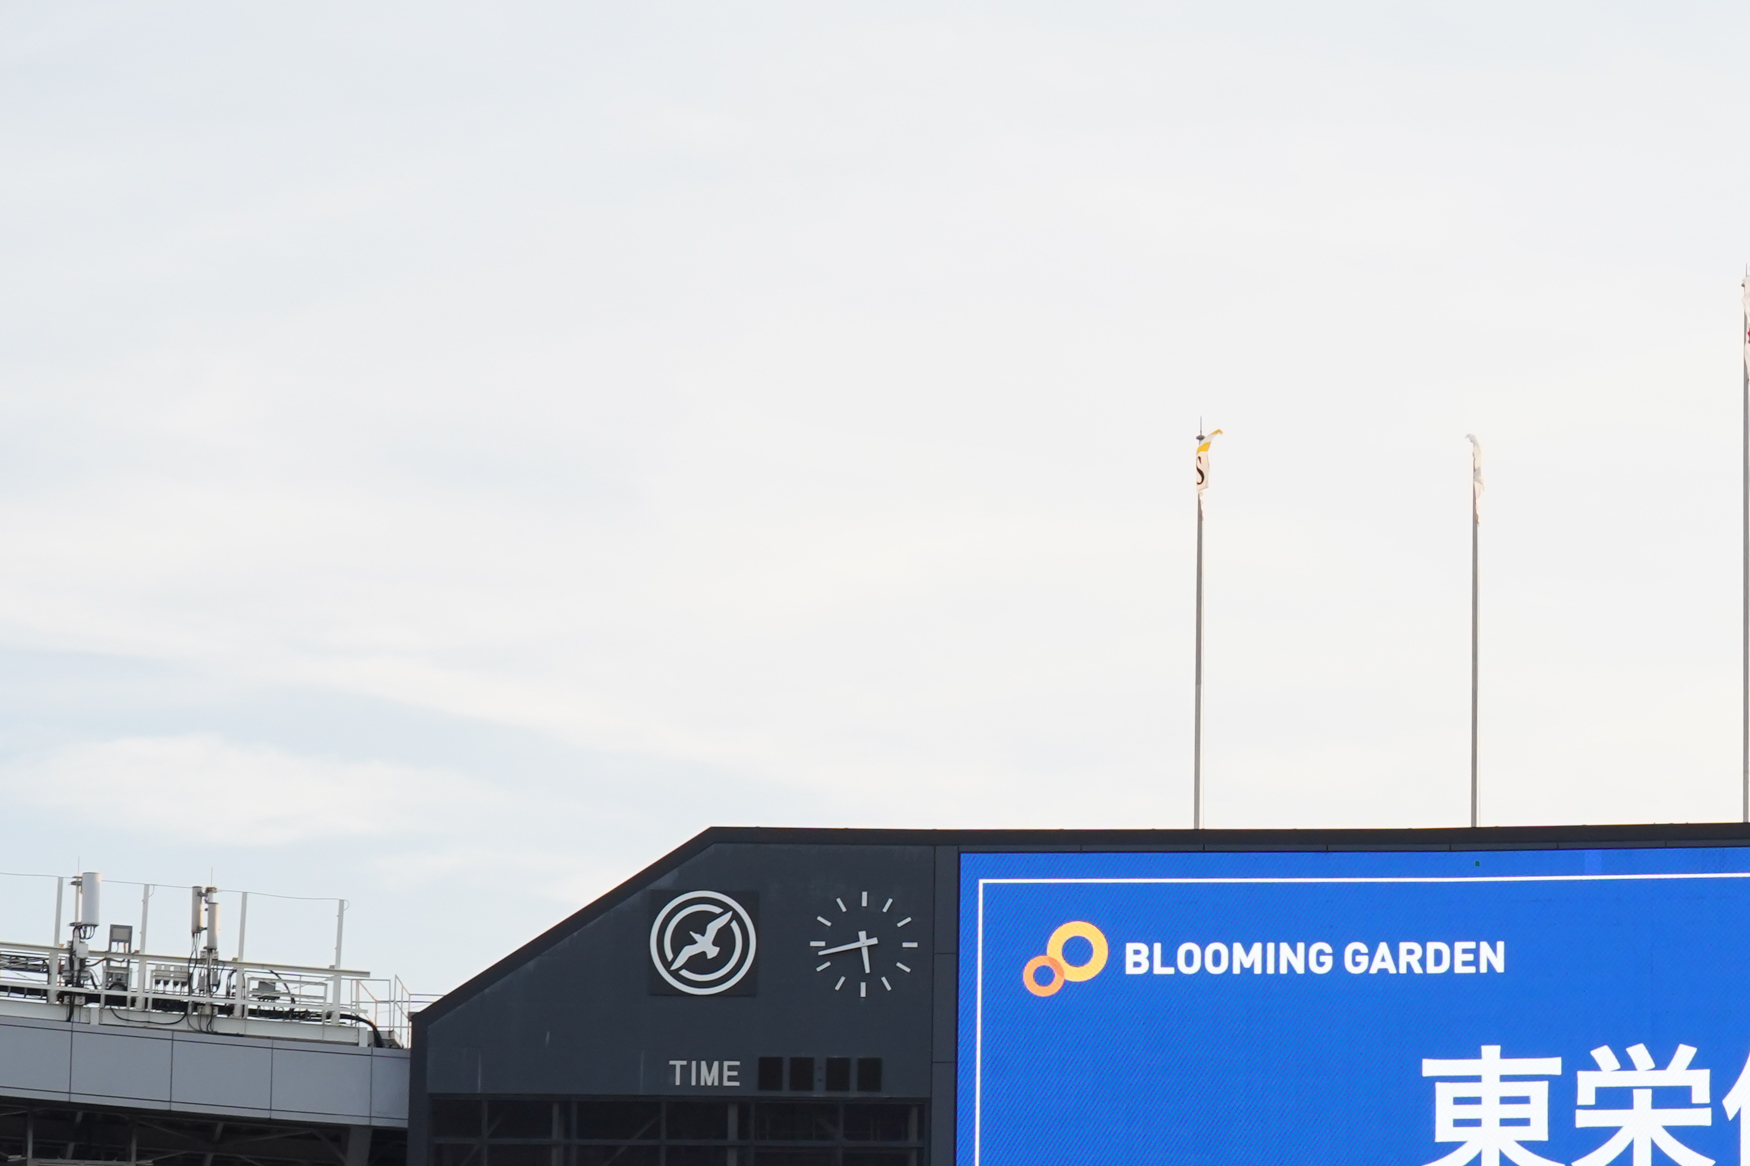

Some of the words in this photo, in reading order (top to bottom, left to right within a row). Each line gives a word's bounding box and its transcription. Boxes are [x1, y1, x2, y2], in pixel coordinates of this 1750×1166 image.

[1125, 941, 1333, 974] BLOOMING
[1343, 940, 1505, 974] GARDEN
[669, 1060, 740, 1087] TIME
